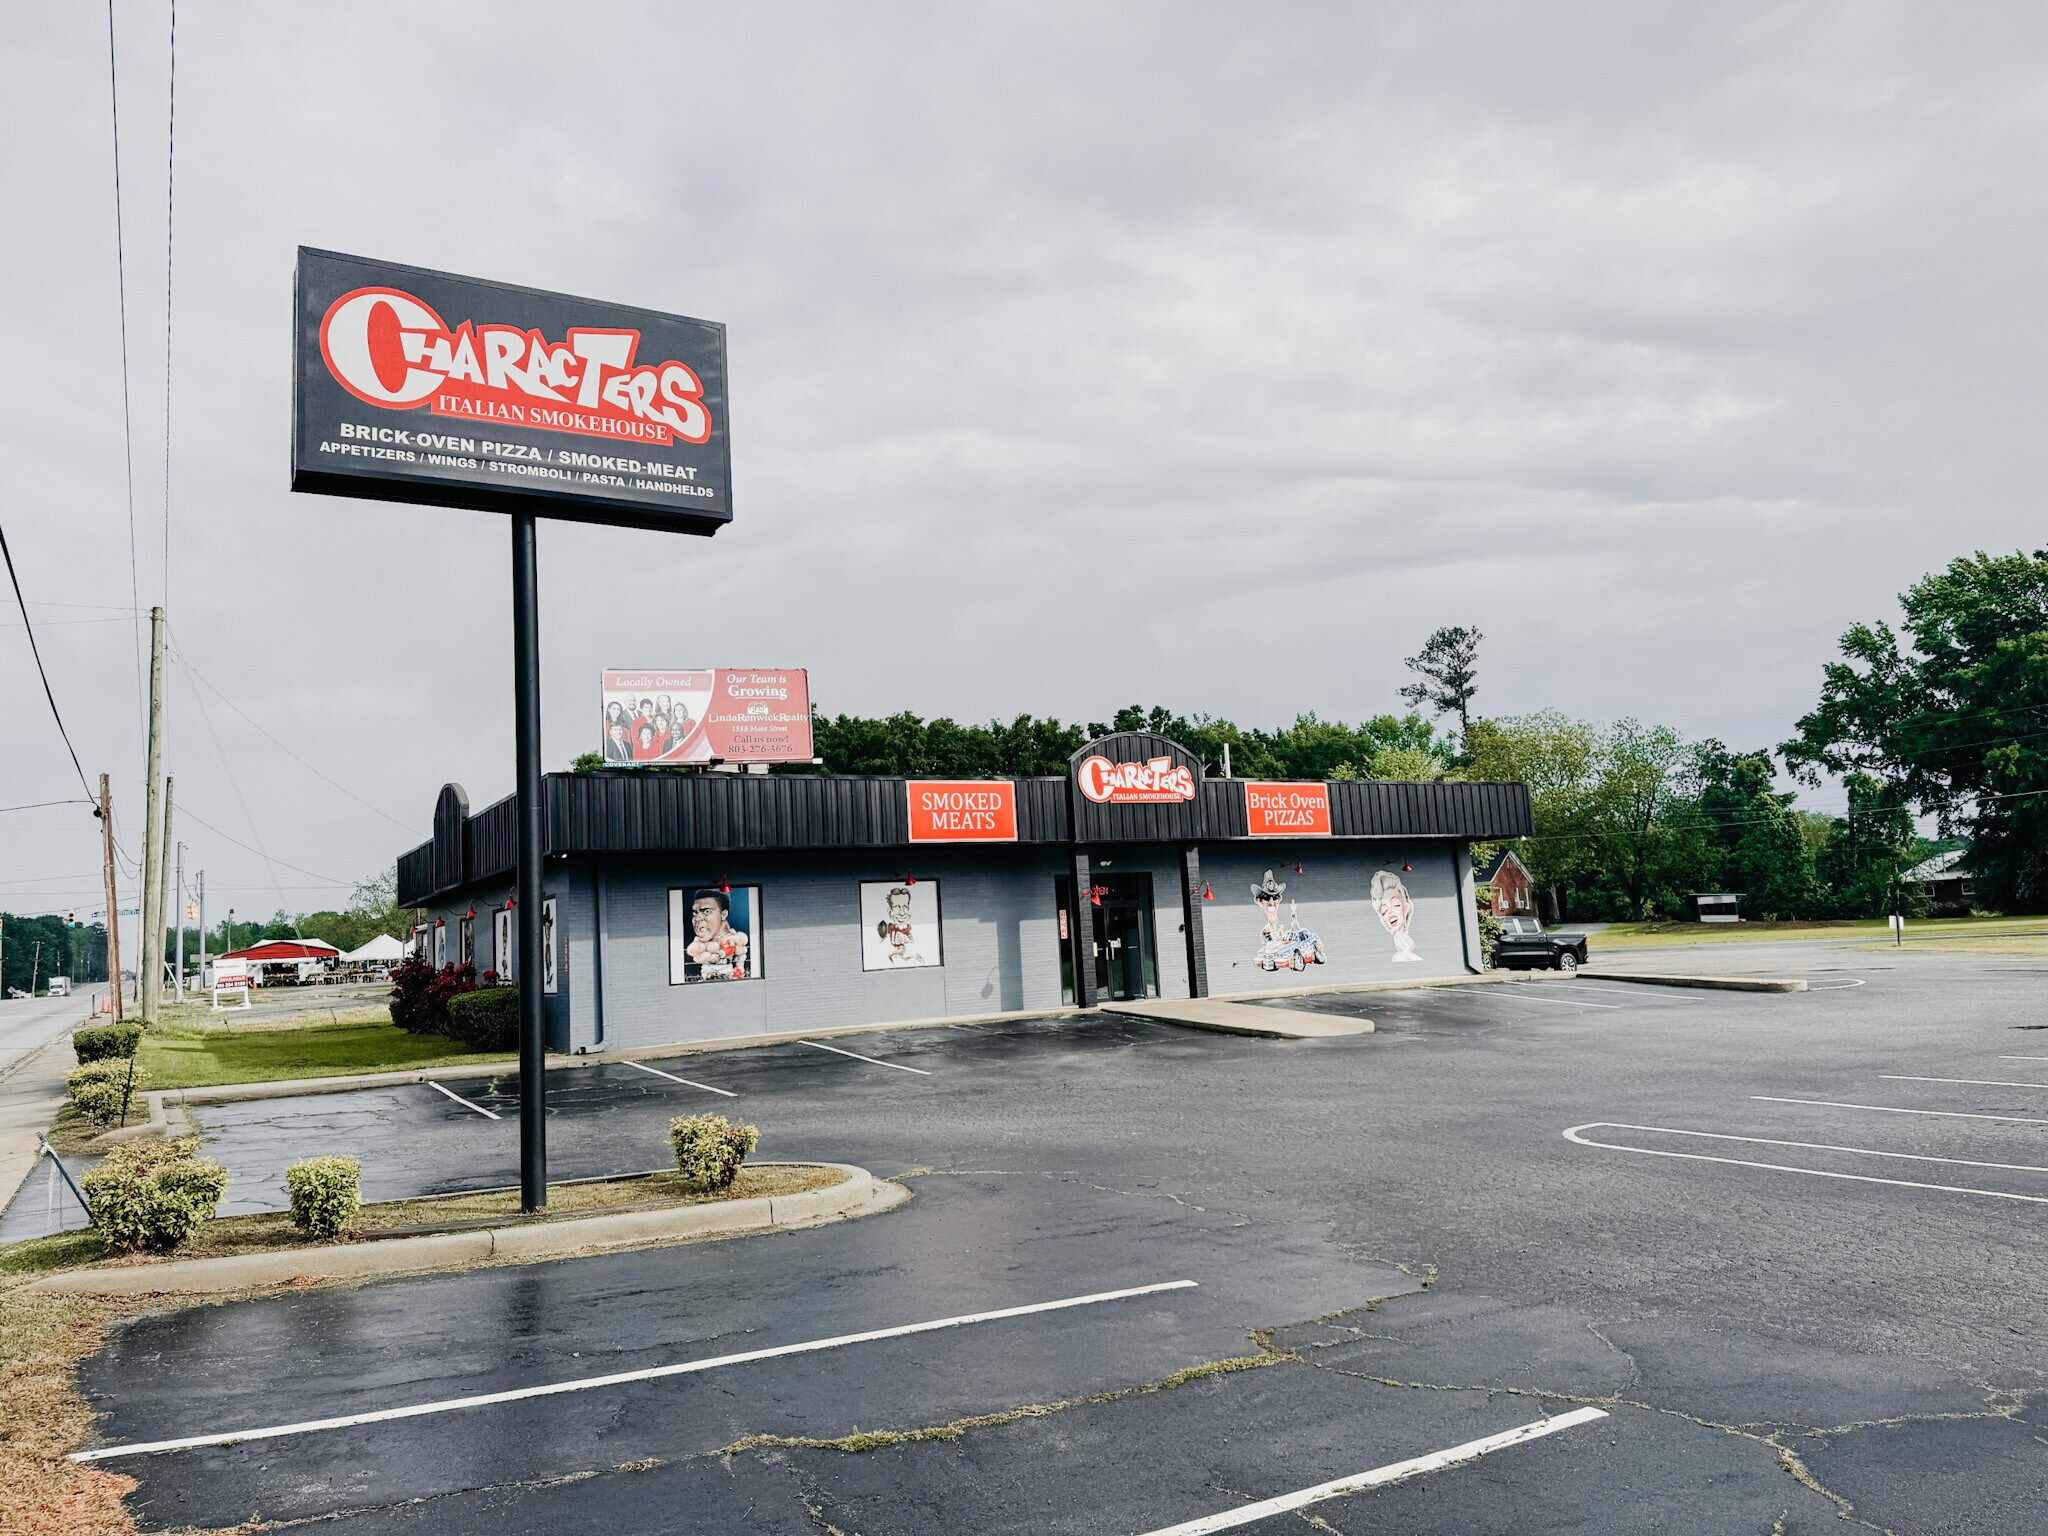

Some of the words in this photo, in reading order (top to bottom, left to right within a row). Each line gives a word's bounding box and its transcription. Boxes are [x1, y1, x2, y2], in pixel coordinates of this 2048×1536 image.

[327, 292, 706, 439] CHARACTERS
[438, 393, 525, 421] ITALIAN
[530, 407, 668, 441] SMOKEHOUSE
[340, 423, 475, 453] BRICK-OVEN
[482, 441, 542, 461] PIZZA
[559, 450, 698, 480] SMOKED-MEAT
[319, 441, 416, 462] APPETIZERS
[427, 454, 478, 470] WINGS
[489, 461, 573, 482] STROMBOLI
[582, 472, 626, 487] PASTA
[636, 479, 714, 498] HANDHELDS
[615, 677, 653, 688] Locally
[656, 676, 692, 687] Owned
[726, 675, 748, 684] Our
[749, 674, 777, 684] Team
[778, 674, 787, 684] is
[728, 685, 788, 700] Growing
[731, 725, 749, 733] 1515
[749, 725, 767, 733] Main
[734, 735, 752, 744] Call
[766, 735, 789, 744] now!
[728, 745, 793, 754] 803-276-3676
[1080, 759, 1193, 800] CHARACTERS
[922, 792, 1002, 810] SMOKED
[1139, 792, 1181, 800] SMOKEHOUSE
[1249, 792, 1288, 809] Brick
[1290, 792, 1325, 809] Oven
[931, 812, 996, 830] MEATS
[1264, 809, 1315, 826] PIZZAS
[1090, 886, 1109, 895] OEN
